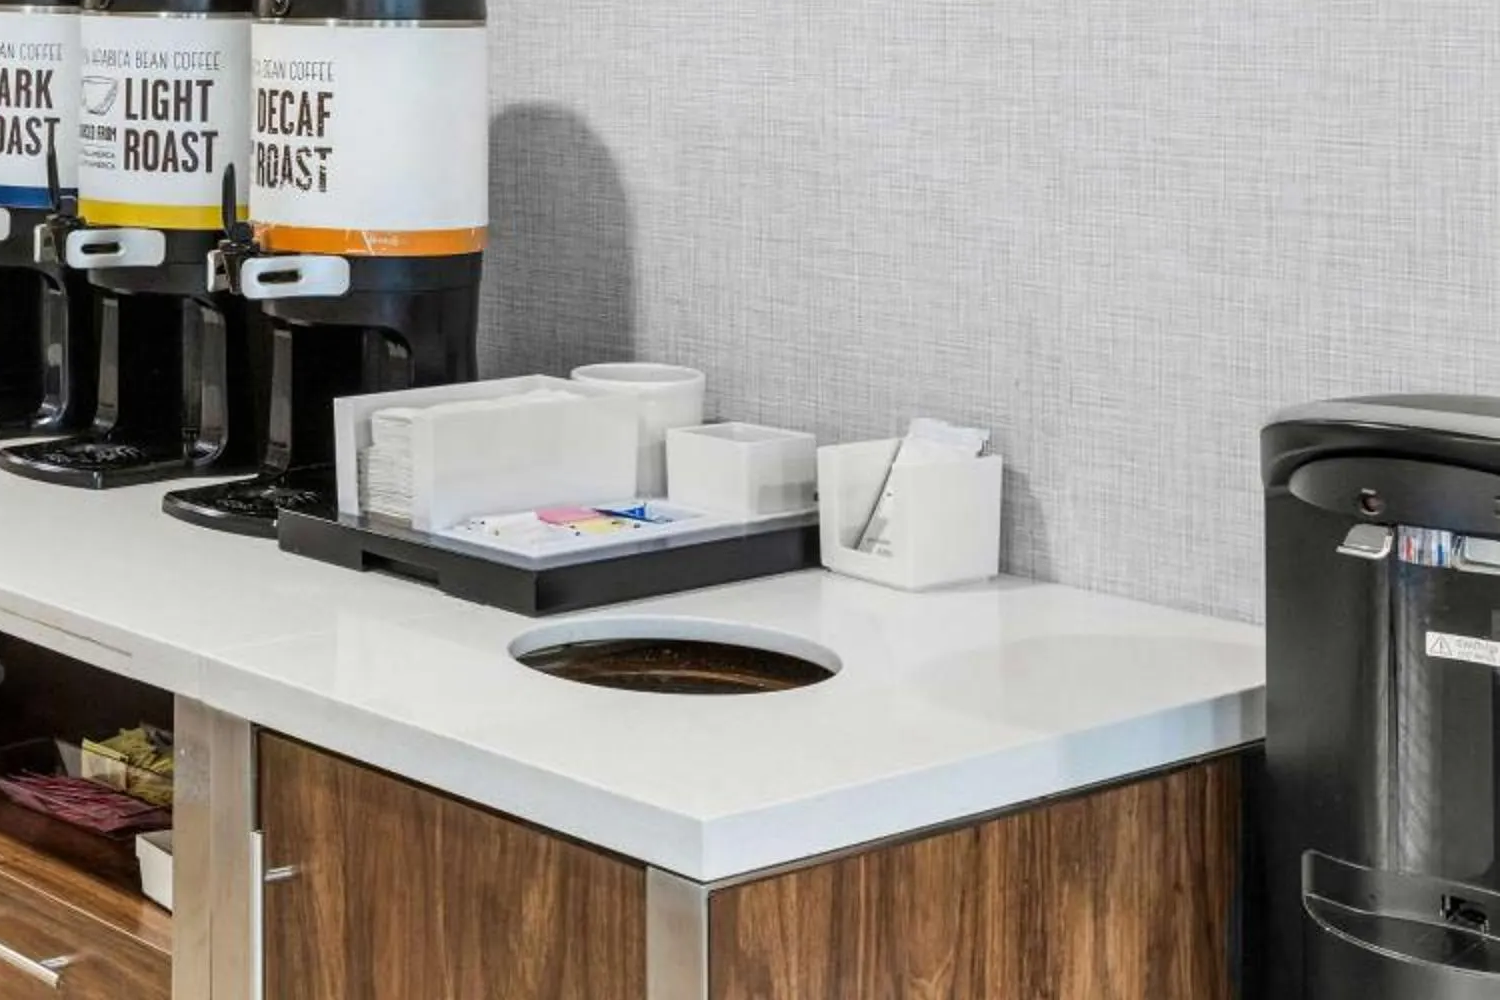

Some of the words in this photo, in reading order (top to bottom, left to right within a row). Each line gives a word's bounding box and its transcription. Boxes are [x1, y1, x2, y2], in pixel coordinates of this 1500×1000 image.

[20, 43, 63, 61] COFFEE
[136, 50, 168, 69] BEAN
[174, 51, 222, 71] COFFEE
[289, 61, 336, 82] COFFEE
[125, 77, 215, 123] LIGHT
[257, 87, 334, 138] DECAF
[123, 128, 219, 173] ROAST
[256, 141, 333, 193] ROAST
